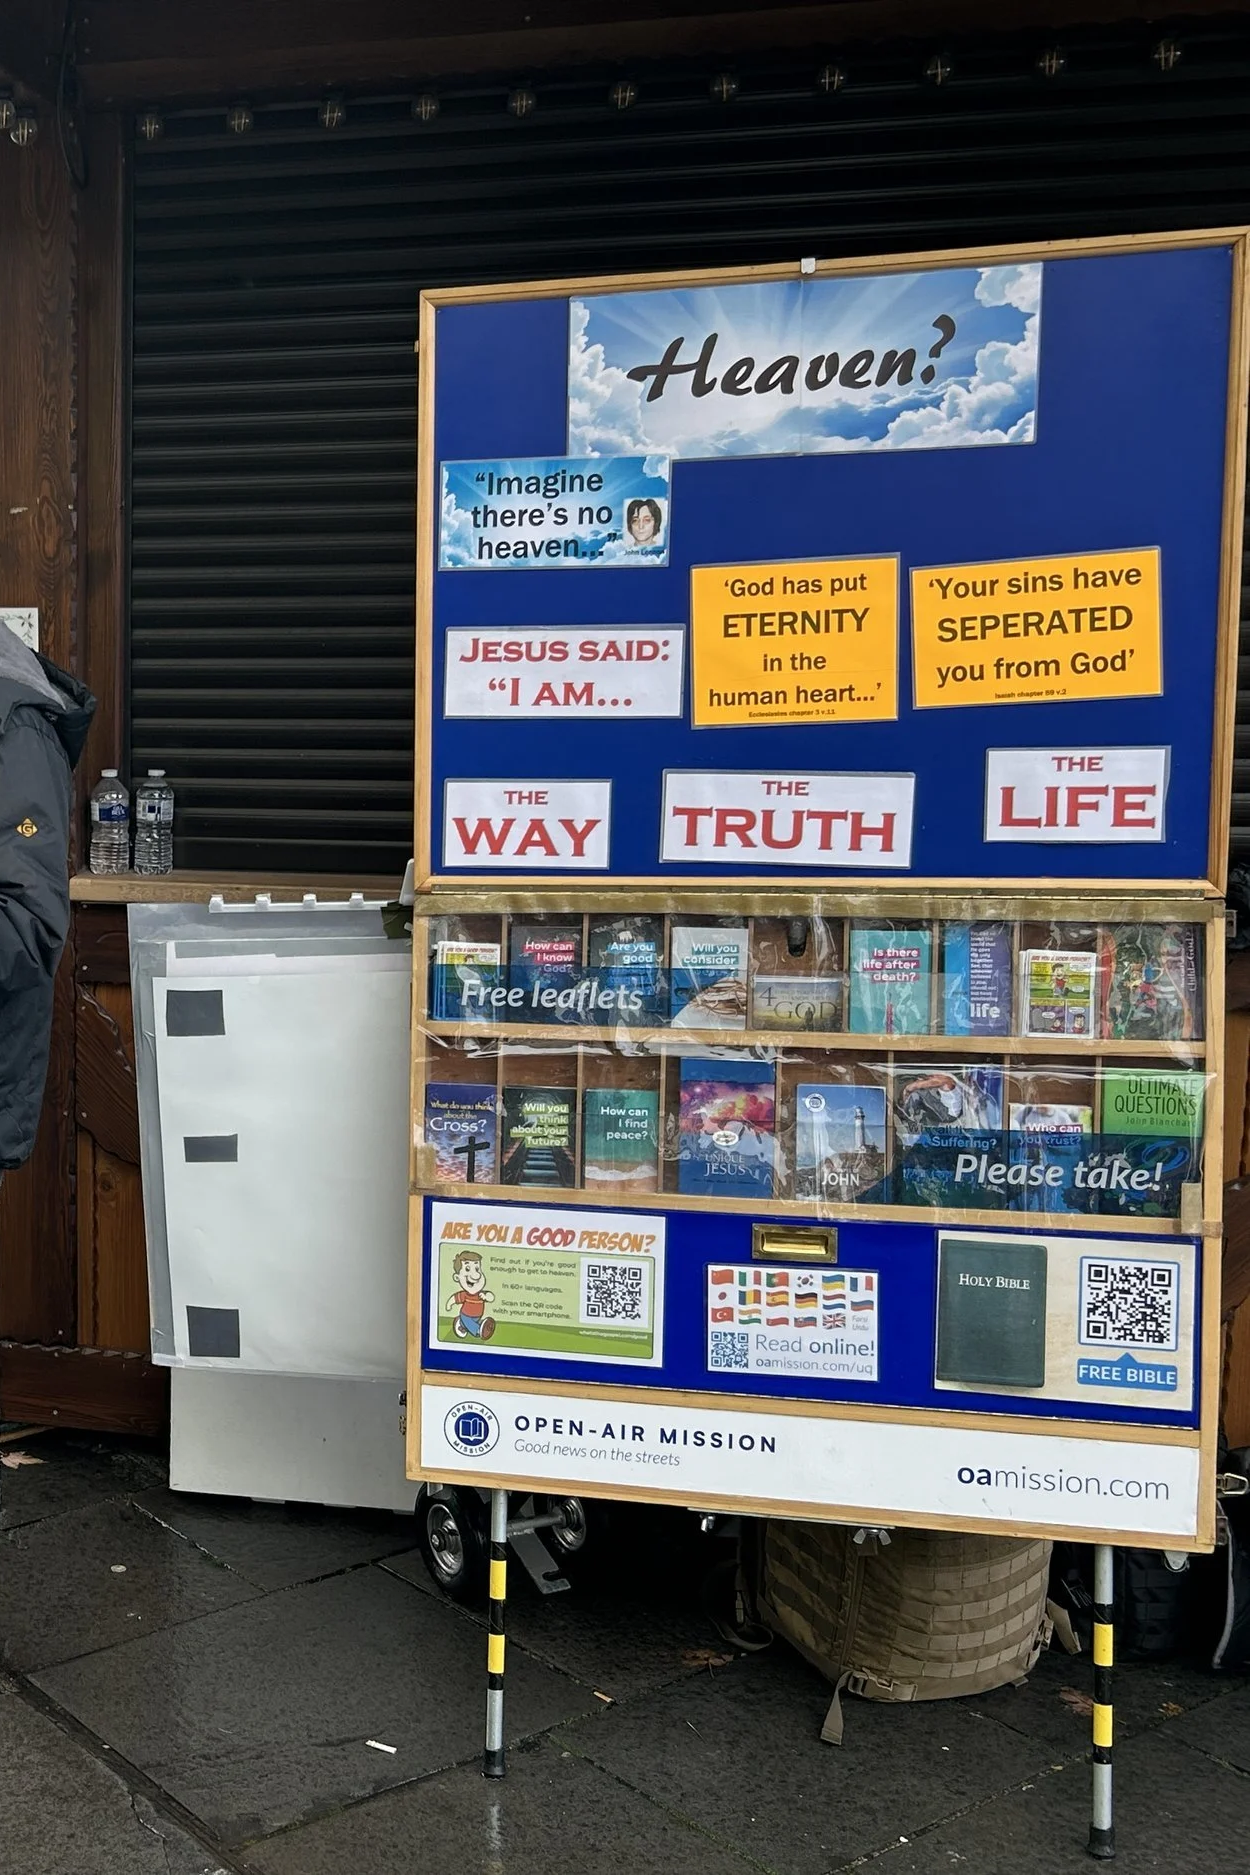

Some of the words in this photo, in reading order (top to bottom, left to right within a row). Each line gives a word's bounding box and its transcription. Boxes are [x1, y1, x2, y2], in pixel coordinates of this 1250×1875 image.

[626, 314, 956, 402] Heaven?
[470, 502, 572, 530] there’s
[577, 504, 614, 527] no
[781, 574, 823, 596] has
[829, 574, 869, 598] put
[1007, 570, 1066, 596] sins
[1072, 565, 1143, 591] have
[721, 607, 872, 640] ETERNITY
[935, 606, 1134, 644] SEPERATED
[459, 637, 570, 664] JESUS
[577, 638, 671, 663] SAID:
[761, 652, 784, 673] in
[788, 650, 828, 672] the
[935, 663, 987, 688] you
[992, 656, 1063, 680] from
[531, 681, 633, 708] AM...
[707, 684, 786, 707] human
[1017, 690, 1044, 698] chapter
[789, 709, 814, 717] chapter
[1051, 755, 1104, 773] THE
[761, 780, 810, 797] THE
[504, 790, 548, 806] THE
[999, 784, 1157, 829] LIFE
[671, 806, 896, 853] TRUTH
[452, 819, 602, 856] WAY
[524, 941, 551, 951] How
[552, 942, 573, 951] can
[610, 942, 630, 951] Are
[632, 944, 654, 953] you
[692, 943, 714, 953] Will
[716, 946, 738, 954] you
[873, 948, 884, 957] Is
[886, 948, 919, 957] there
[542, 953, 573, 962] know
[622, 953, 653, 965] good
[683, 955, 737, 965] consider
[863, 958, 883, 969] life
[885, 960, 917, 969] after
[543, 964, 573, 973] God?
[873, 972, 917, 982] death?
[461, 979, 525, 1008] Free
[531, 980, 644, 1013] leaflets
[758, 985, 778, 1007] 4
[774, 1000, 839, 1020] GOD
[970, 1002, 1001, 1018] life
[1127, 1076, 1199, 1097] ULTIMATE
[430, 1101, 449, 1110] What
[475, 1102, 494, 1111] think
[524, 1103, 545, 1112] Will
[547, 1104, 568, 1114] you
[600, 1106, 626, 1116] How
[1114, 1095, 1197, 1116] QUESTIONS
[443, 1110, 464, 1119] about
[539, 1115, 567, 1124] think
[1125, 1115, 1147, 1125] John
[430, 1117, 487, 1132] Cross?
[624, 1119, 648, 1128] find
[1028, 1123, 1057, 1133] Who
[1059, 1125, 1081, 1133] can
[512, 1125, 542, 1134] about
[543, 1127, 567, 1138] your
[606, 1131, 648, 1141] peace?
[526, 1137, 567, 1146] future?
[932, 1136, 997, 1151] Suffering?
[1019, 1136, 1042, 1146] you
[1045, 1136, 1081, 1146] trust?
[705, 1154, 745, 1163] UNIQUE
[704, 1163, 746, 1176] JESUS
[954, 1155, 1064, 1188] Please
[1074, 1160, 1163, 1192] take!
[821, 1172, 860, 1186] JOHN
[440, 1222, 472, 1240] ARE
[476, 1224, 509, 1244] YOU
[510, 1225, 524, 1245] A
[526, 1227, 575, 1248] GOOD
[578, 1231, 656, 1254] PERSON?
[489, 1265, 517, 1274] enough
[527, 1268, 538, 1276] get
[533, 1260, 554, 1268] you’re
[525, 1284, 564, 1294] languages.
[958, 1272, 991, 1289] HOLY
[995, 1274, 1031, 1291] BIBLE
[492, 1307, 509, 1315] with
[509, 1309, 526, 1318] your
[526, 1310, 573, 1320] smartphone.
[533, 1302, 545, 1310] QR
[755, 1333, 806, 1354] Read
[809, 1337, 876, 1358] online!
[755, 1356, 873, 1376] oamission.com/uq
[1078, 1364, 1123, 1383] FREE
[1127, 1367, 1178, 1386] BIBLE
[451, 1404, 493, 1421] OPEN-AIR
[514, 1415, 646, 1443] OPEN-AIR
[659, 1427, 778, 1454] MISSION
[452, 1440, 491, 1454] MISSION
[513, 1439, 548, 1458] Good
[553, 1444, 585, 1457] news
[588, 1446, 603, 1458] on
[608, 1445, 631, 1461] the
[635, 1448, 681, 1467] streets
[957, 1466, 1171, 1502] oamission.com
